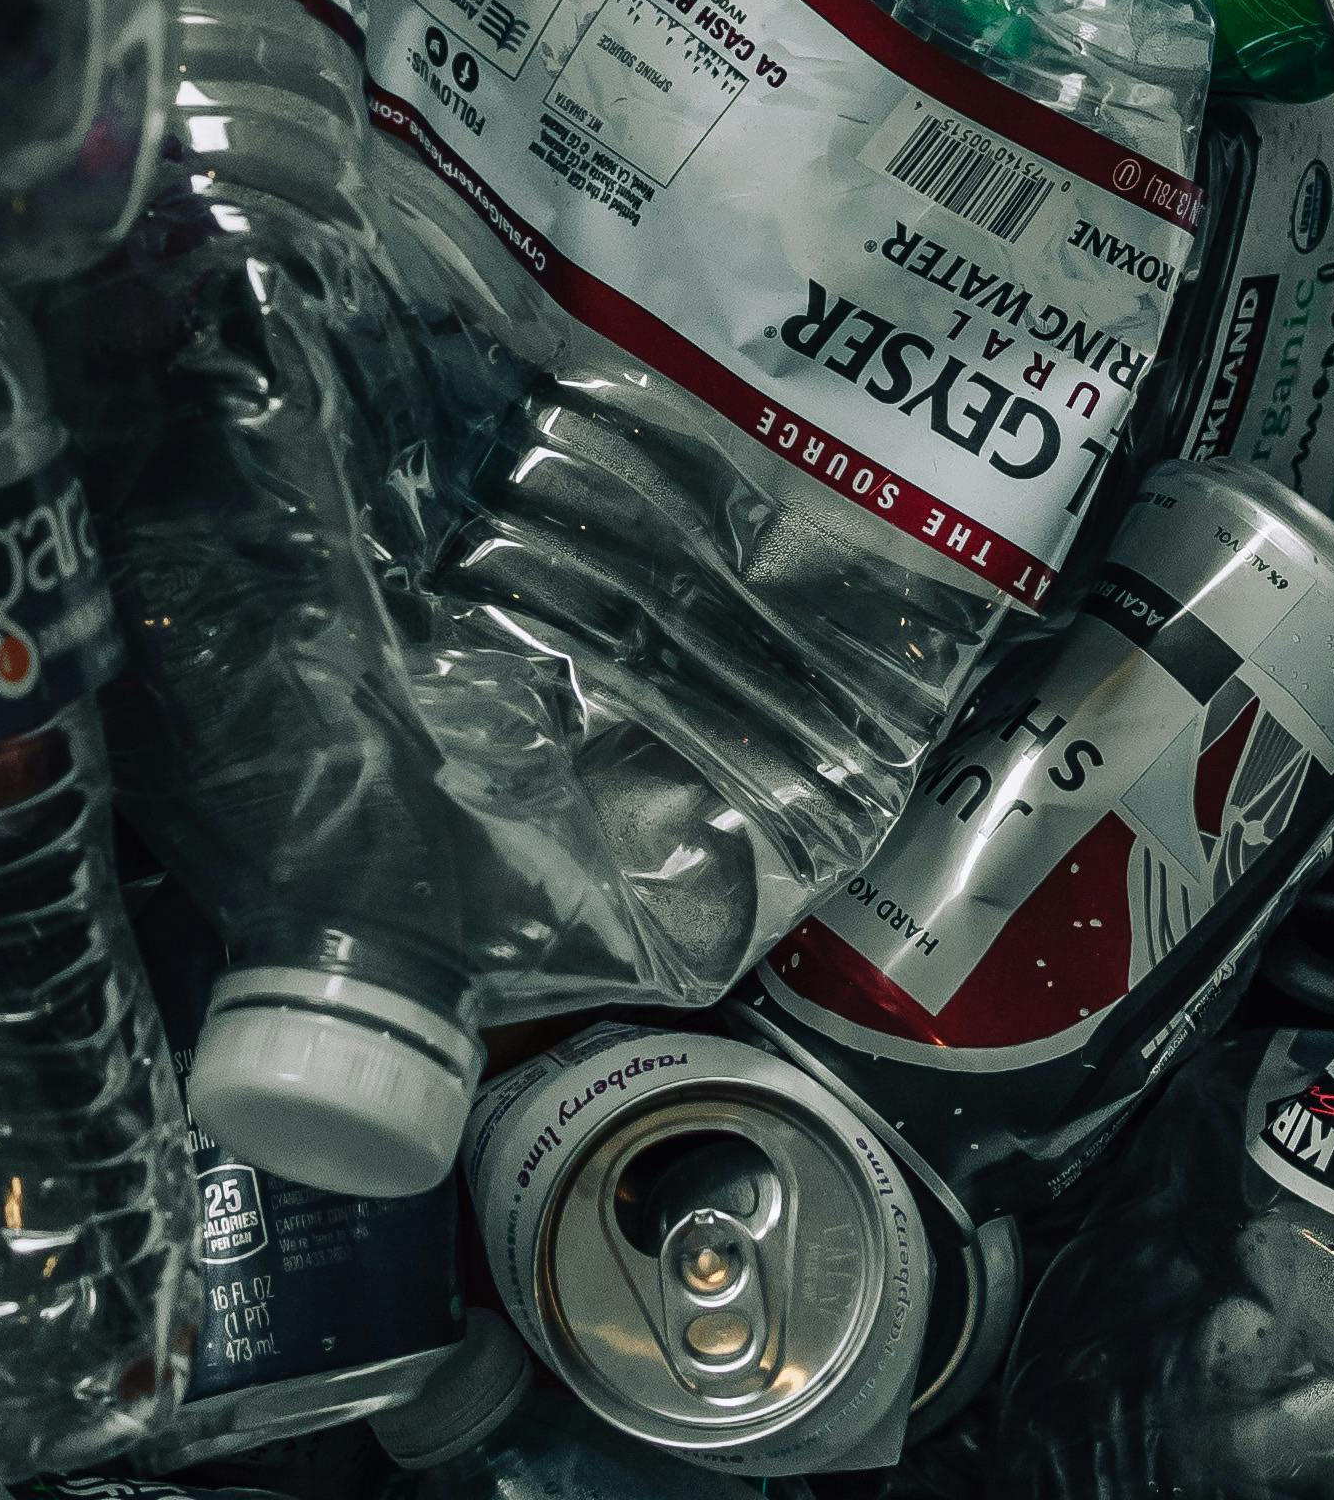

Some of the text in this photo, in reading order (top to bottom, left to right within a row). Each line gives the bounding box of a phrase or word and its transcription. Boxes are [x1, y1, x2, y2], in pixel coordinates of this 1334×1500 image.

[596, 34, 673, 93] SPRING SOURCE
[694, 11, 756, 61] CASH
[756, 56, 788, 89] CA
[430, 74, 486, 137] FOLLOW
[880, 220, 1015, 314] WATER
[779, 278, 1062, 481] GEYSER
[754, 407, 996, 569] SOURCE THE
[873, 897, 941, 959] HARD
[514, 1046, 689, 1191] raspberry lime
[204, 1178, 244, 1218] 25
[210, 1281, 230, 1311] 16
[231, 1278, 251, 1308] FL
[224, 1334, 254, 1361] 473
